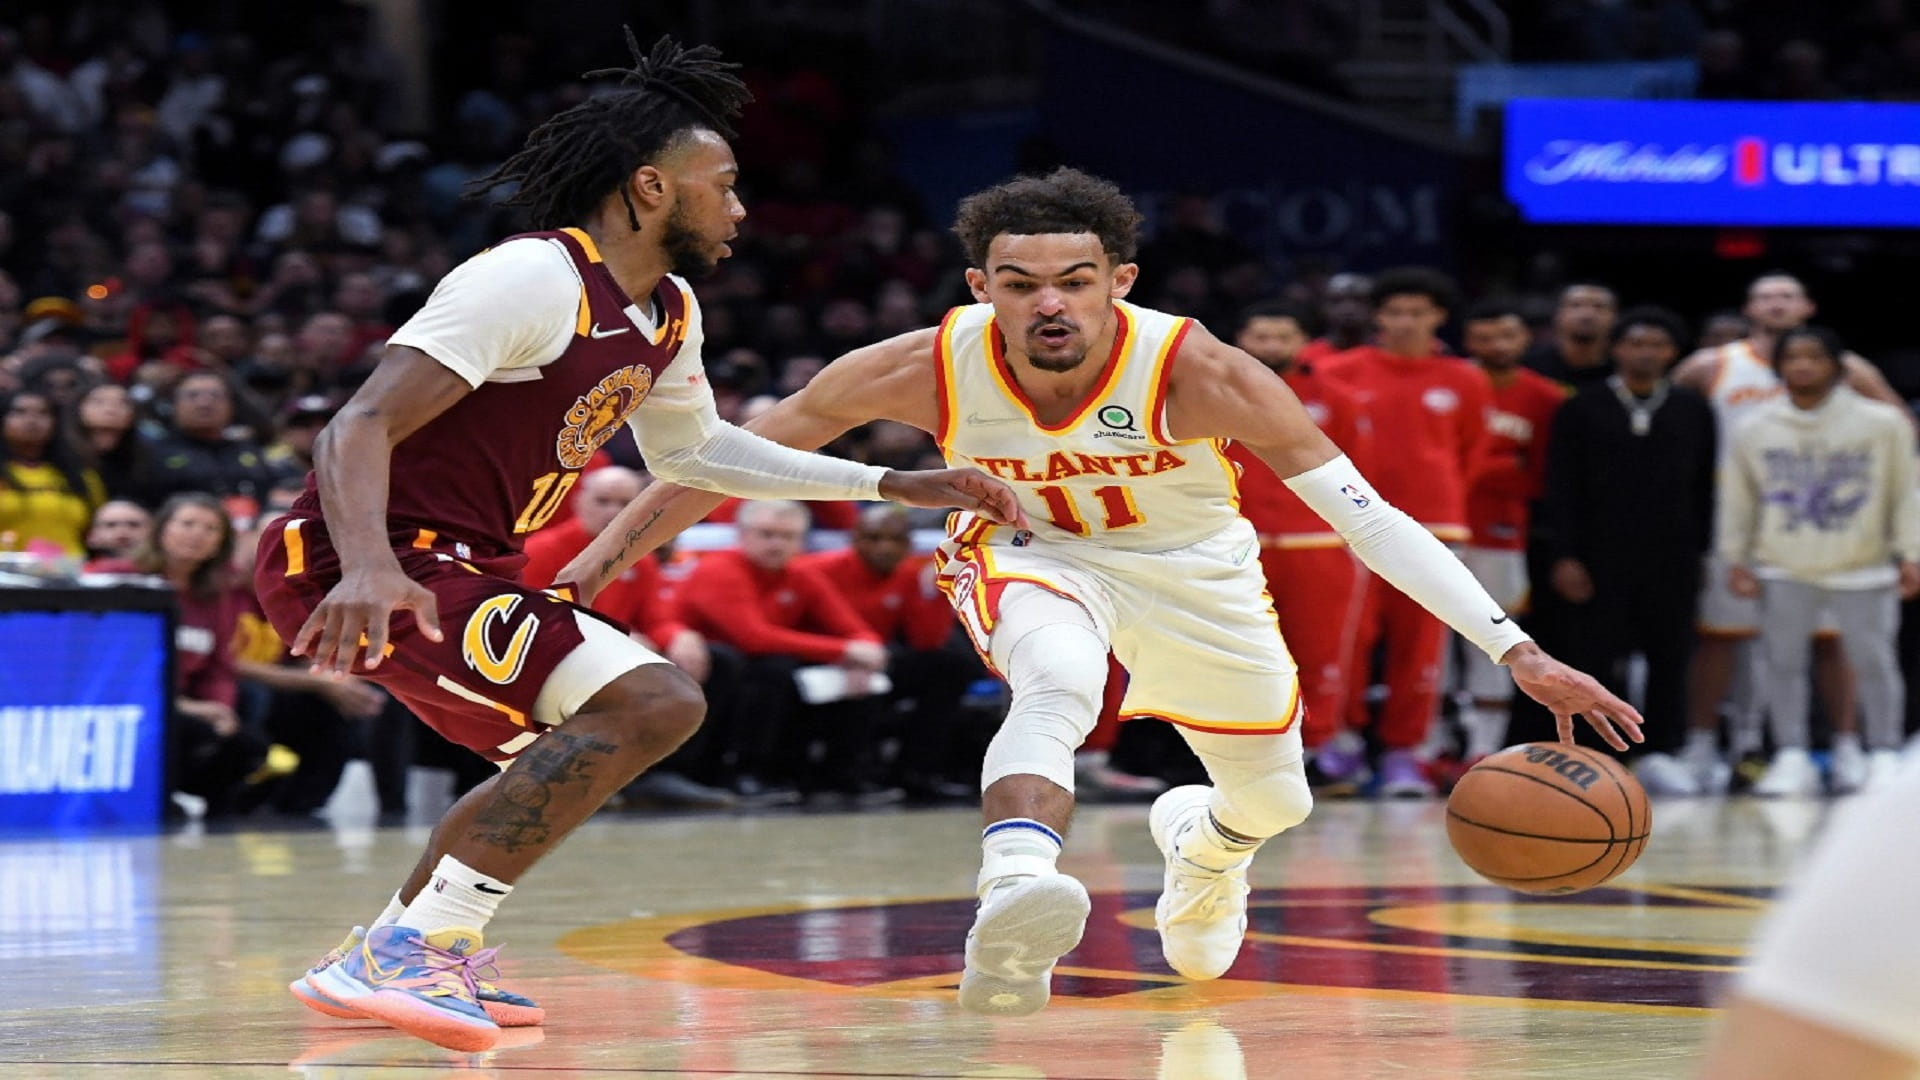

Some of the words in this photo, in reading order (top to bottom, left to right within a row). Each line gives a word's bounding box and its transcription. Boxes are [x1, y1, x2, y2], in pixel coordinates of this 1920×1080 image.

[972, 449, 1186, 482] TLANTA
[513, 472, 580, 534] 10
[1033, 485, 1147, 537] 11
